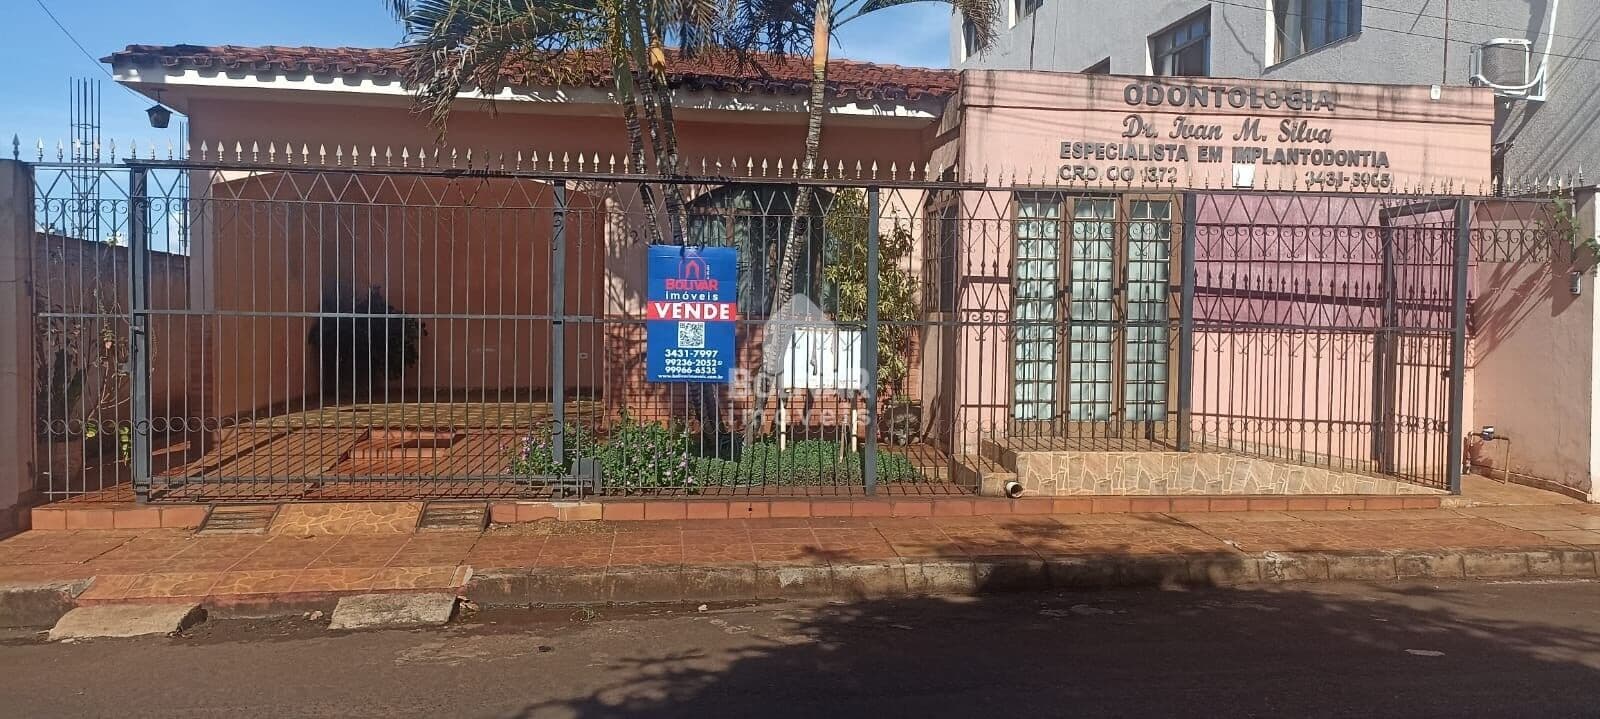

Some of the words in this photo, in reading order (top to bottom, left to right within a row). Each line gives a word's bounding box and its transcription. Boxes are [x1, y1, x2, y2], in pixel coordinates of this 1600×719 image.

[1123, 82, 1334, 111] ODONTOLOGIA
[1122, 114, 1158, 139] Dr.
[1169, 115, 1223, 140] Ivan
[1232, 117, 1266, 142] M.
[1278, 118, 1332, 144] Silva
[1060, 141, 1188, 162] ESPECIALISTA
[1198, 145, 1223, 163] EM
[1232, 146, 1390, 168] IMPLANTODONTIA
[1141, 166, 1177, 183] 1372
[665, 278, 718, 290] BOLIVAR
[665, 290, 719, 301] imóveis
[654, 302, 730, 320] VENDE
[665, 349, 718, 358] 3431-7997
[665, 358, 717, 367] 99236-2052
[665, 366, 716, 374] 99966-6535
